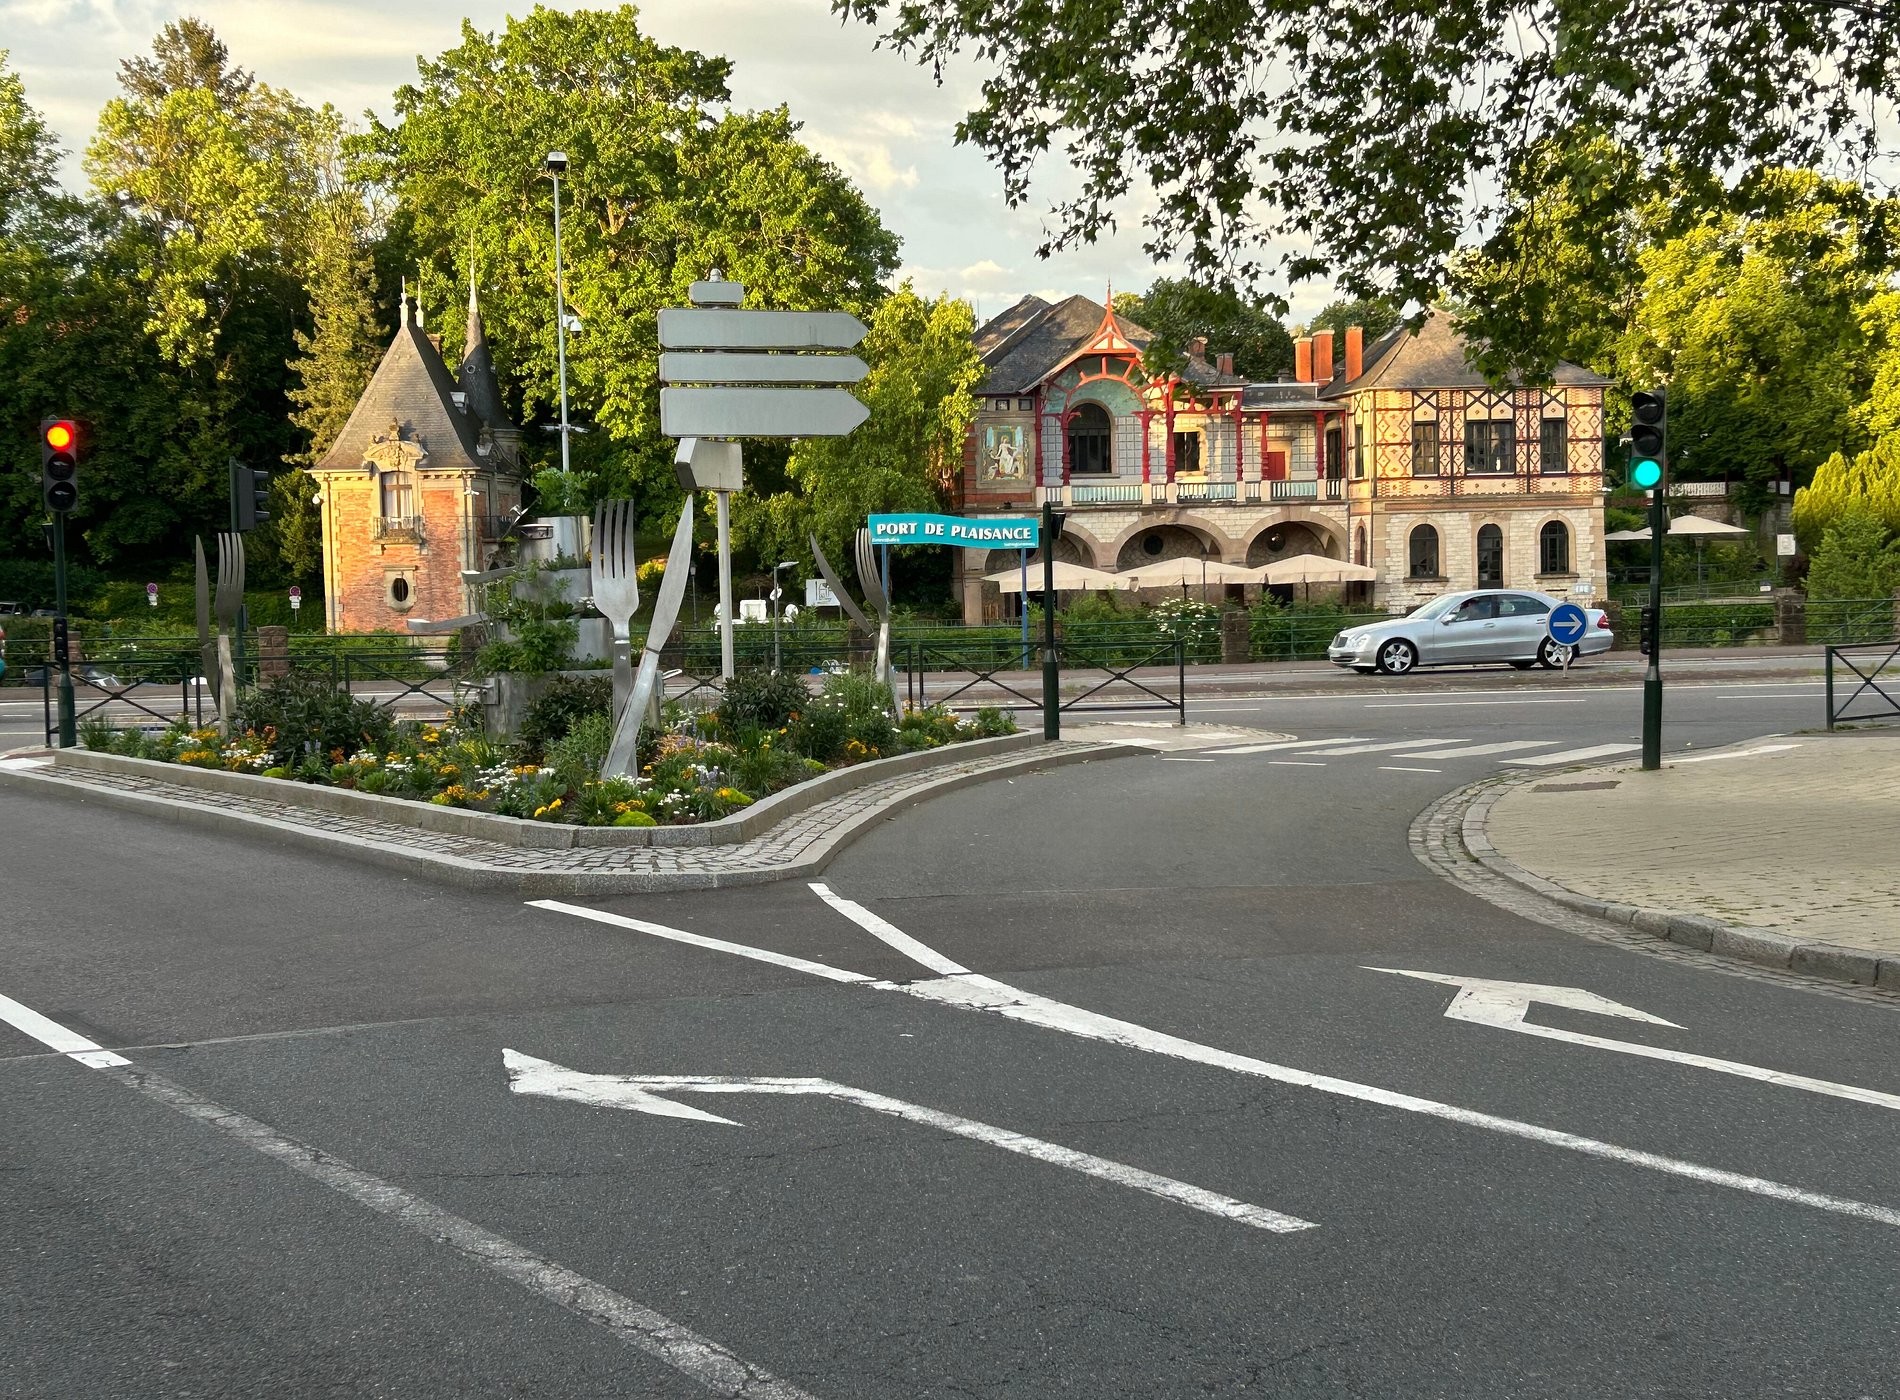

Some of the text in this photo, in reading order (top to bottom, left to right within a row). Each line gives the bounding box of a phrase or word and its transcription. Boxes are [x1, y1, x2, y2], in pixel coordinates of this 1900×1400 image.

[876, 522, 1032, 539] PORT DE PLAISANCE
